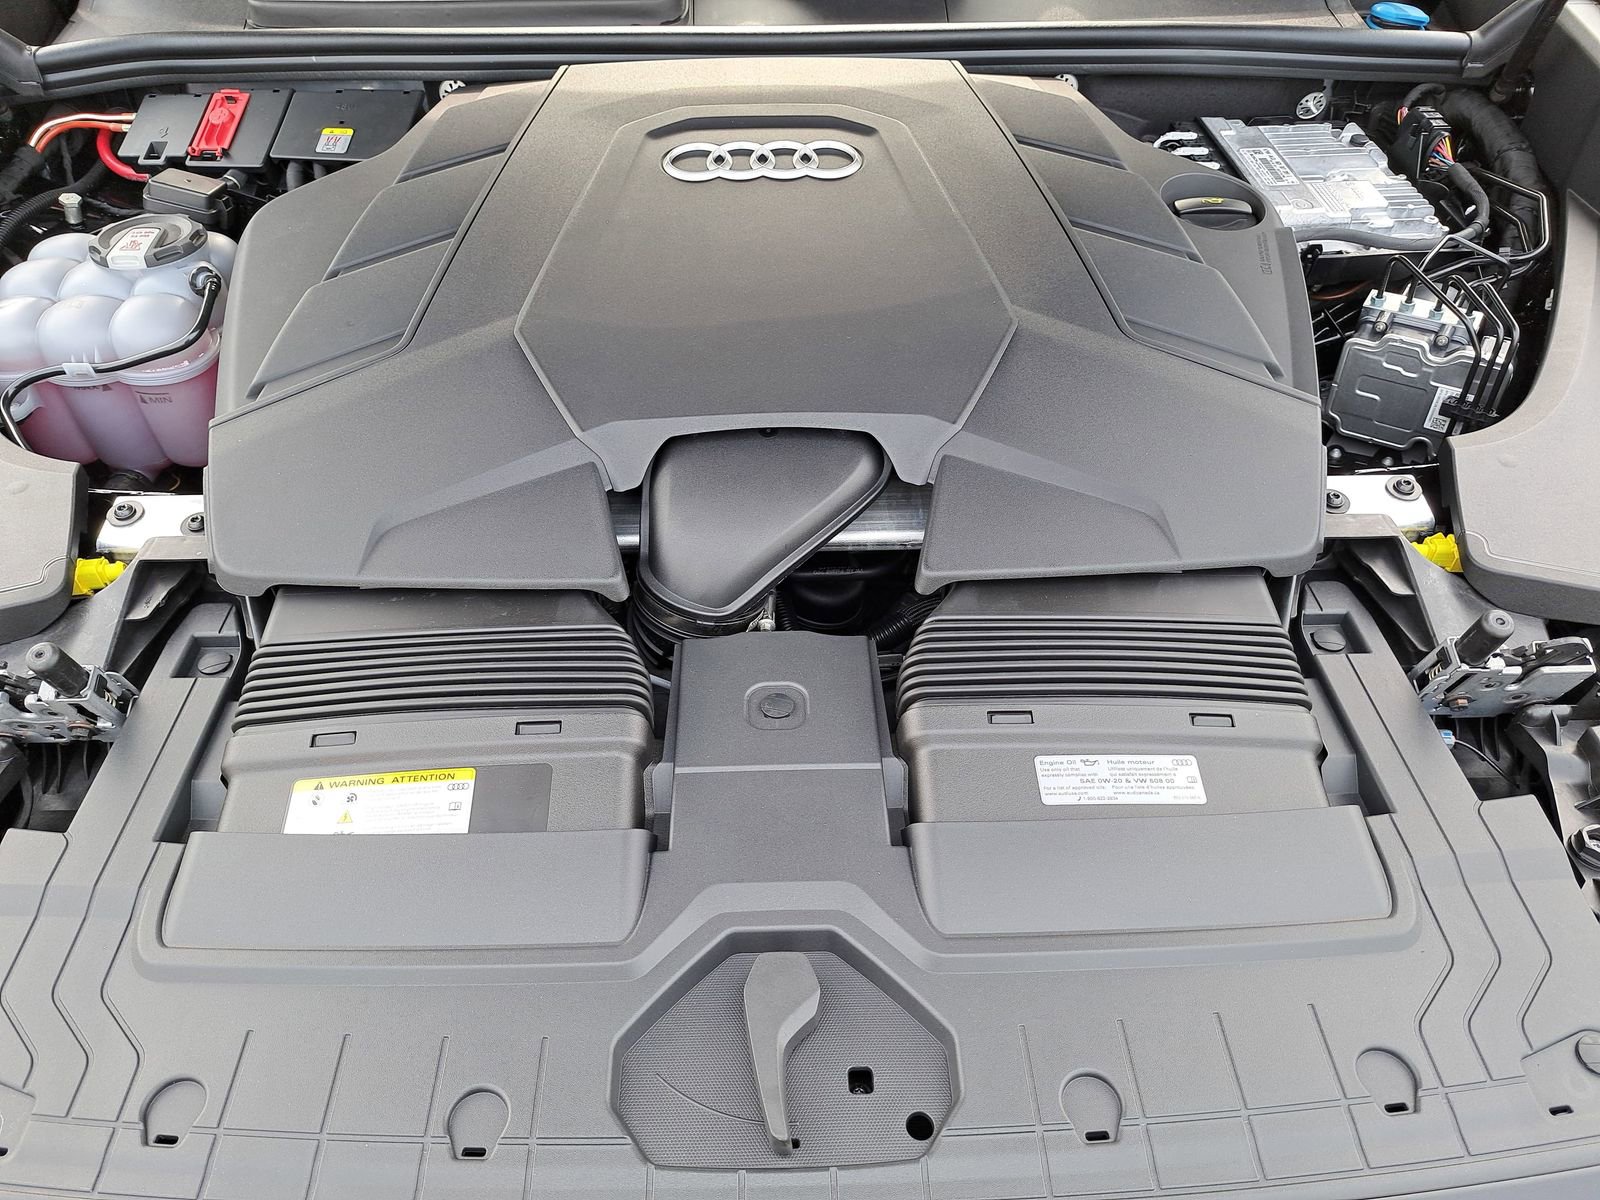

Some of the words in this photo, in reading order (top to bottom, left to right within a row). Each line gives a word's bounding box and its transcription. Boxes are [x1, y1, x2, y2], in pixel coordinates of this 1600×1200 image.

[149, 395, 173, 404] MIN
[329, 777, 384, 789] WARNING
[391, 772, 455, 784] ATTENTION
